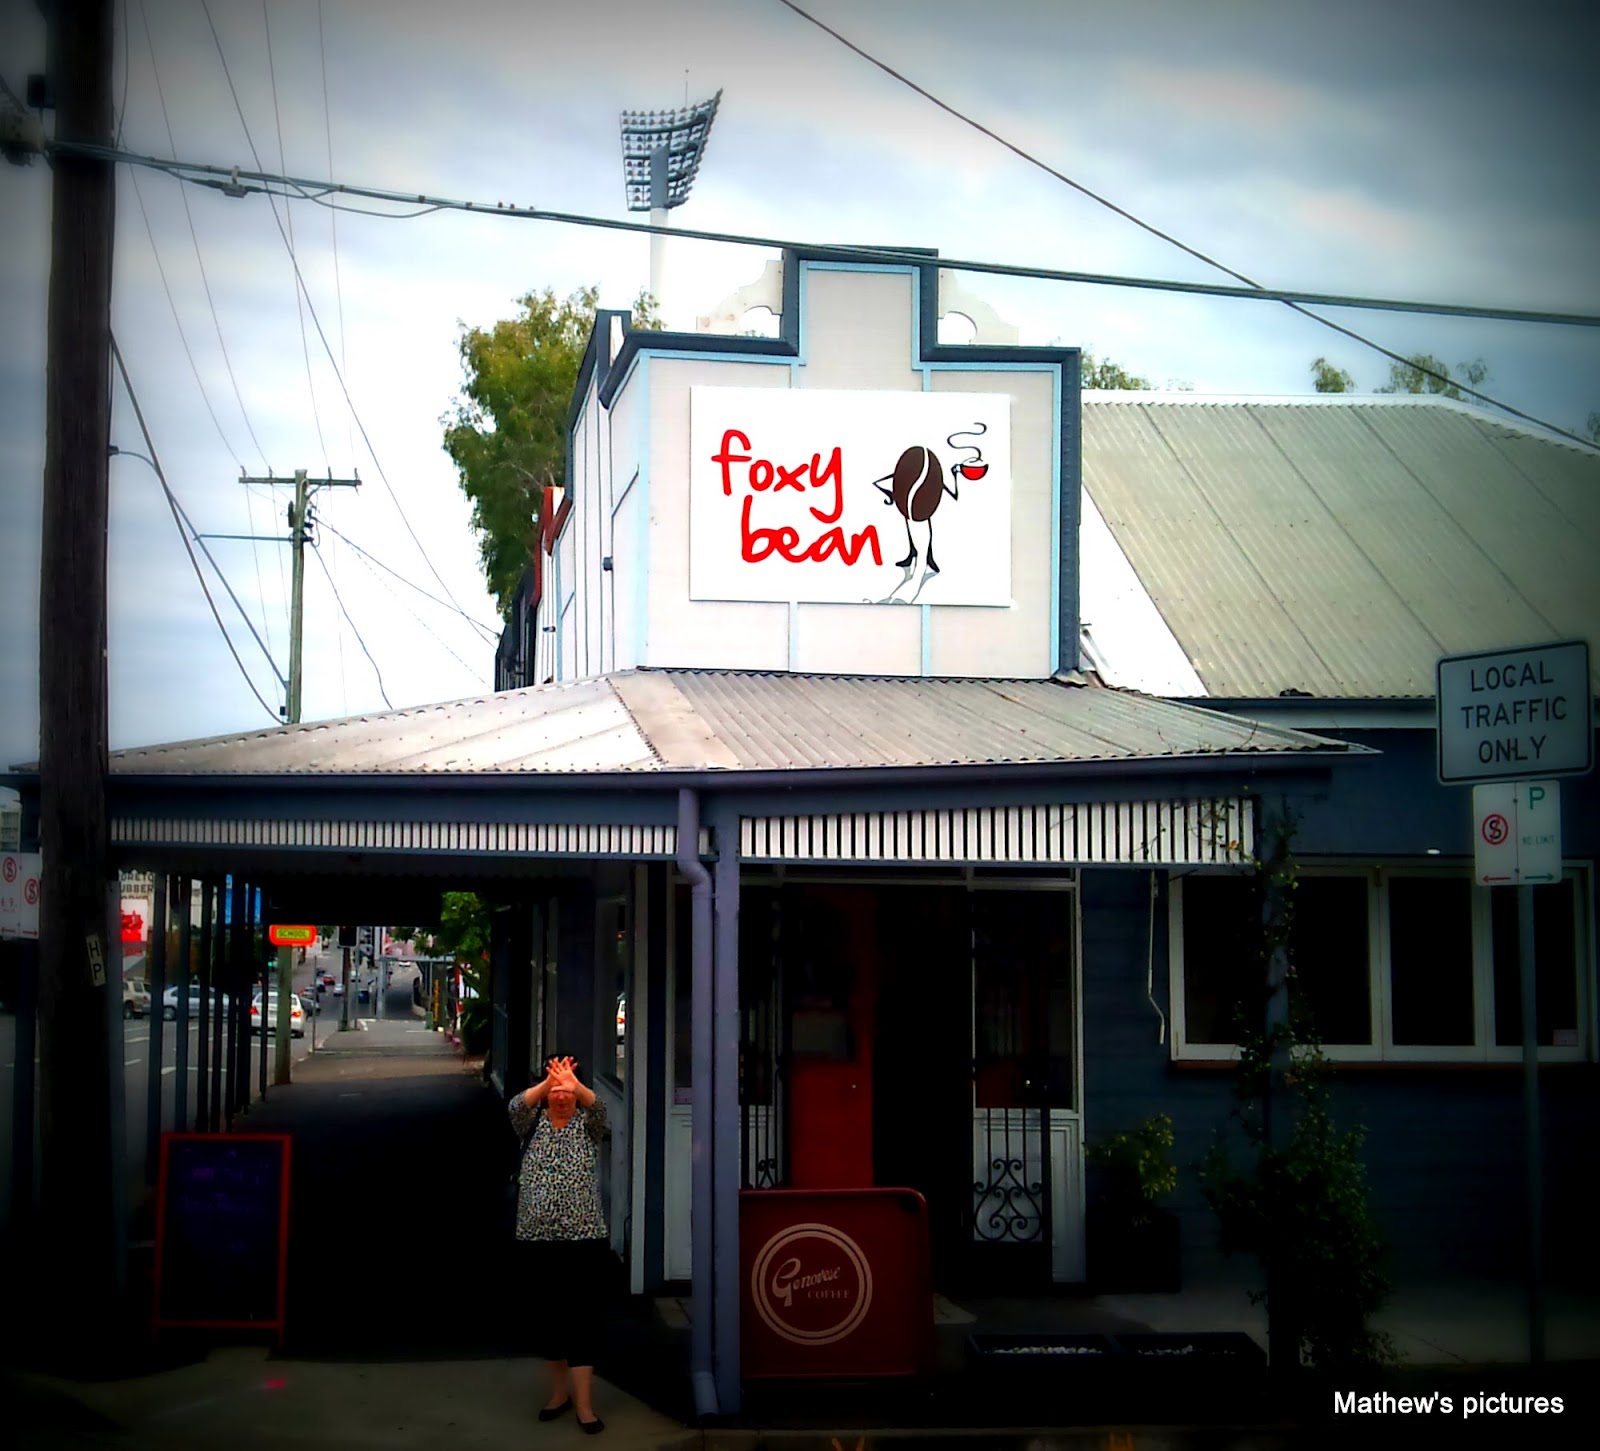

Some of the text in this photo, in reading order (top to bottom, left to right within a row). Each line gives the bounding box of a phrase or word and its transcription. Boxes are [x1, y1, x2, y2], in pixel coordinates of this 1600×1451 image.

[711, 429, 843, 524] foxy
[741, 495, 883, 566] bean
[1470, 661, 1554, 692] LOCAL
[1461, 696, 1567, 729] TRAFFIC
[1479, 735, 1547, 764] ONLY
[1529, 786, 1546, 810] P
[121, 884, 154, 893] UBBER
[807, 1289, 850, 1300] COFFEE
